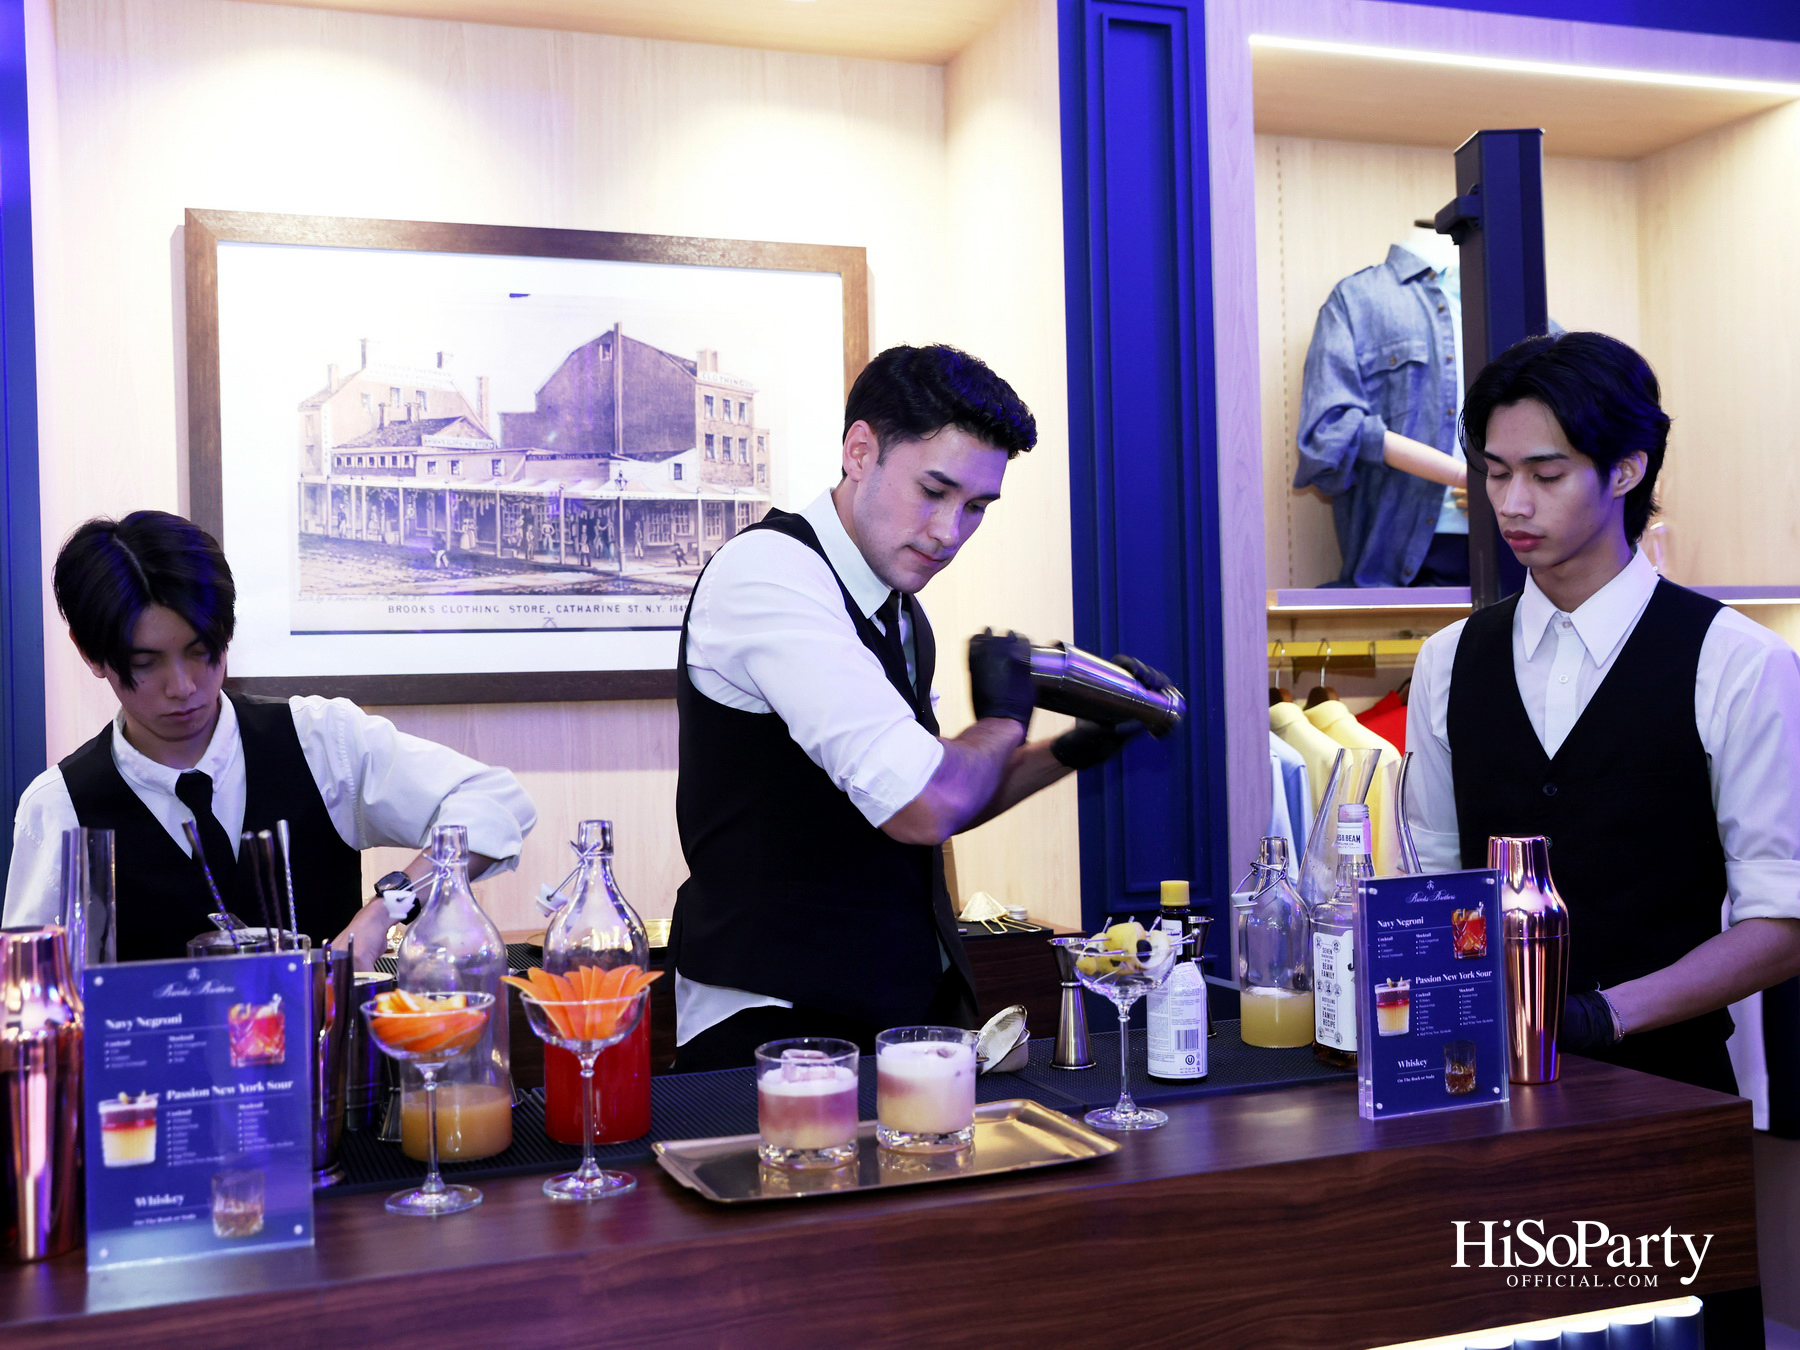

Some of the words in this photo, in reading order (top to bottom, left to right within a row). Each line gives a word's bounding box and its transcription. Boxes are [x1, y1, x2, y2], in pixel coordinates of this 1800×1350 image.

[388, 605, 435, 613] BROOKS
[442, 605, 499, 613] CLOTHING
[509, 605, 550, 614] STORE,
[556, 605, 620, 613] CATHARINE
[669, 605, 688, 613] 184
[1377, 920, 1395, 929] Navy
[1396, 916, 1424, 928] Negroni
[1415, 975, 1441, 985] Passion
[1443, 973, 1457, 981] New
[1459, 971, 1475, 980] York
[1476, 970, 1492, 978] Sour
[105, 1019, 132, 1031] Navy
[136, 1013, 183, 1029] Negroni
[1397, 1058, 1427, 1069] Whiskey
[166, 1087, 210, 1101] Passion
[212, 1084, 236, 1095] New
[238, 1081, 265, 1093] York
[266, 1080, 294, 1090] Sour
[134, 1193, 185, 1208] Whiskey
